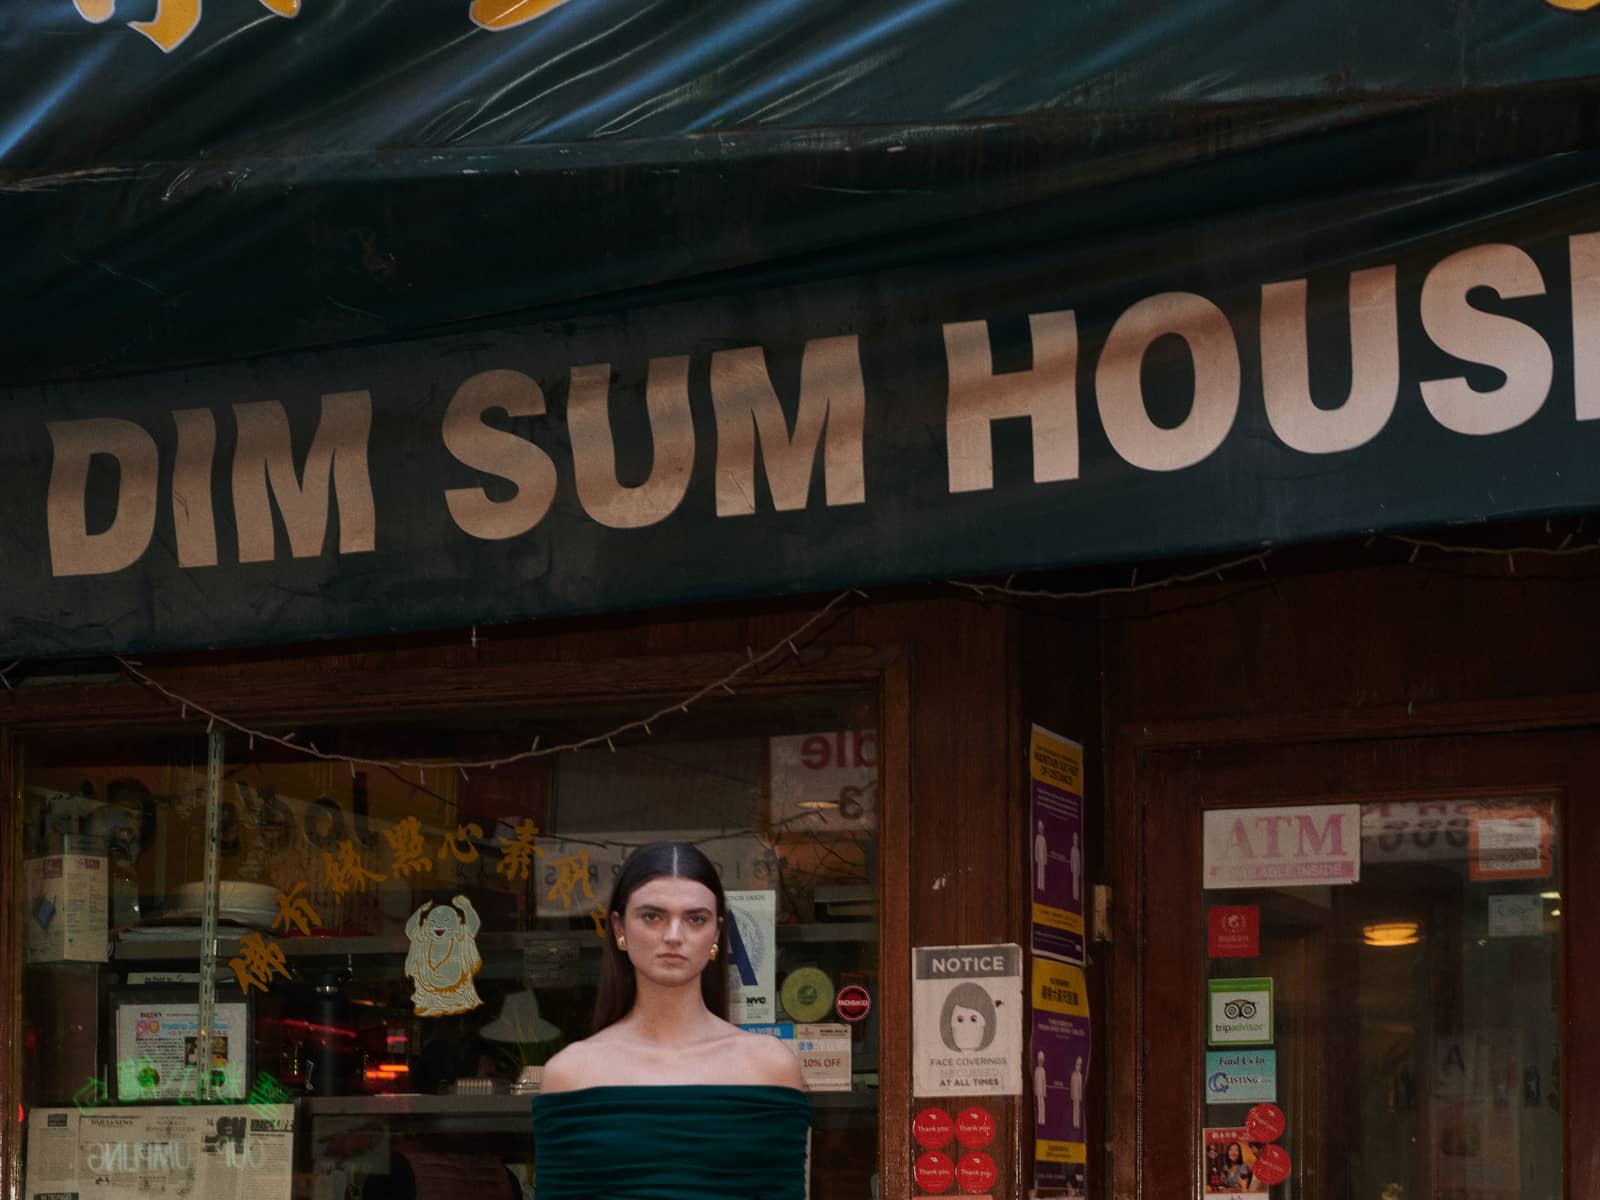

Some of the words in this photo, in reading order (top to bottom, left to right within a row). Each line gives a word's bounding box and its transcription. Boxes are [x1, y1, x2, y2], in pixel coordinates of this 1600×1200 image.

[46, 389, 377, 577] DIM
[441, 334, 866, 541] SUM
[941, 232, 1600, 494] HOUS
[1215, 812, 1347, 859] ATM
[932, 955, 1005, 974] NOTICE
[746, 996, 767, 1006] NYC
[1215, 1022, 1265, 1034] tripadvisor
[803, 1058, 822, 1069] 10%
[823, 1058, 841, 1069] OFF
[929, 1057, 955, 1067] FACE
[955, 1056, 1008, 1067] COVERINGS
[1218, 1055, 1241, 1066] Find
[939, 1079, 952, 1087] AT
[953, 1079, 970, 1087] ALL
[973, 1077, 999, 1087] TIMES
